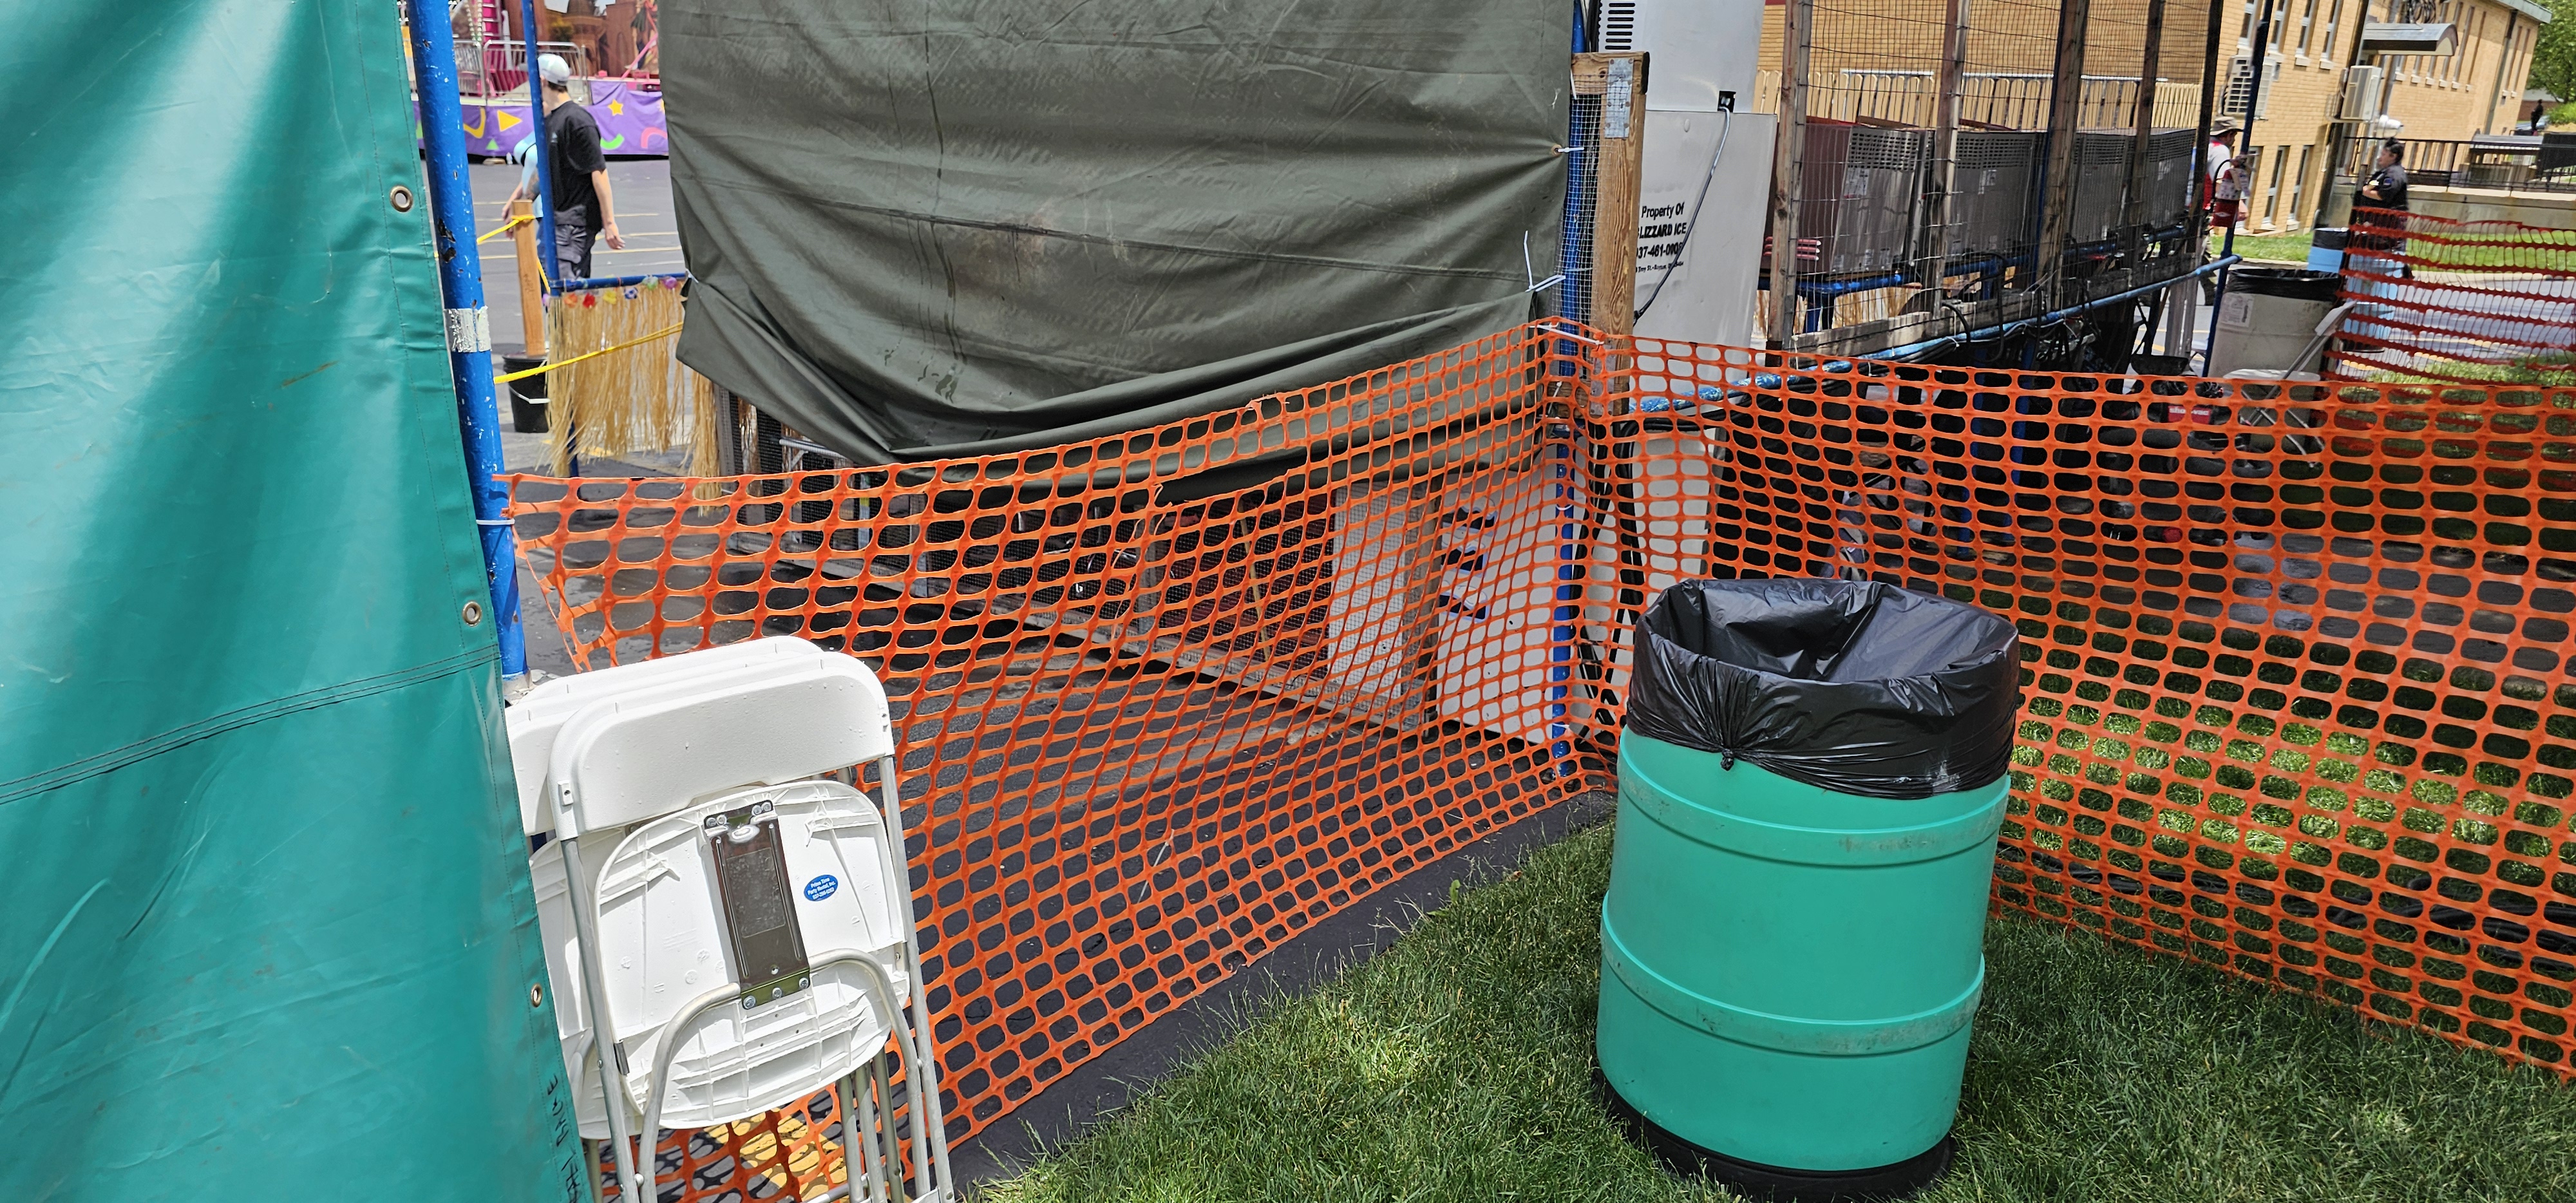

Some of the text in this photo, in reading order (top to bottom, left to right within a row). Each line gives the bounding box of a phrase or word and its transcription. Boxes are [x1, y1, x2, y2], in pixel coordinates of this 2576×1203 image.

[1641, 202, 1685, 220] Property Of
[1674, 222, 1687, 236] ICE
